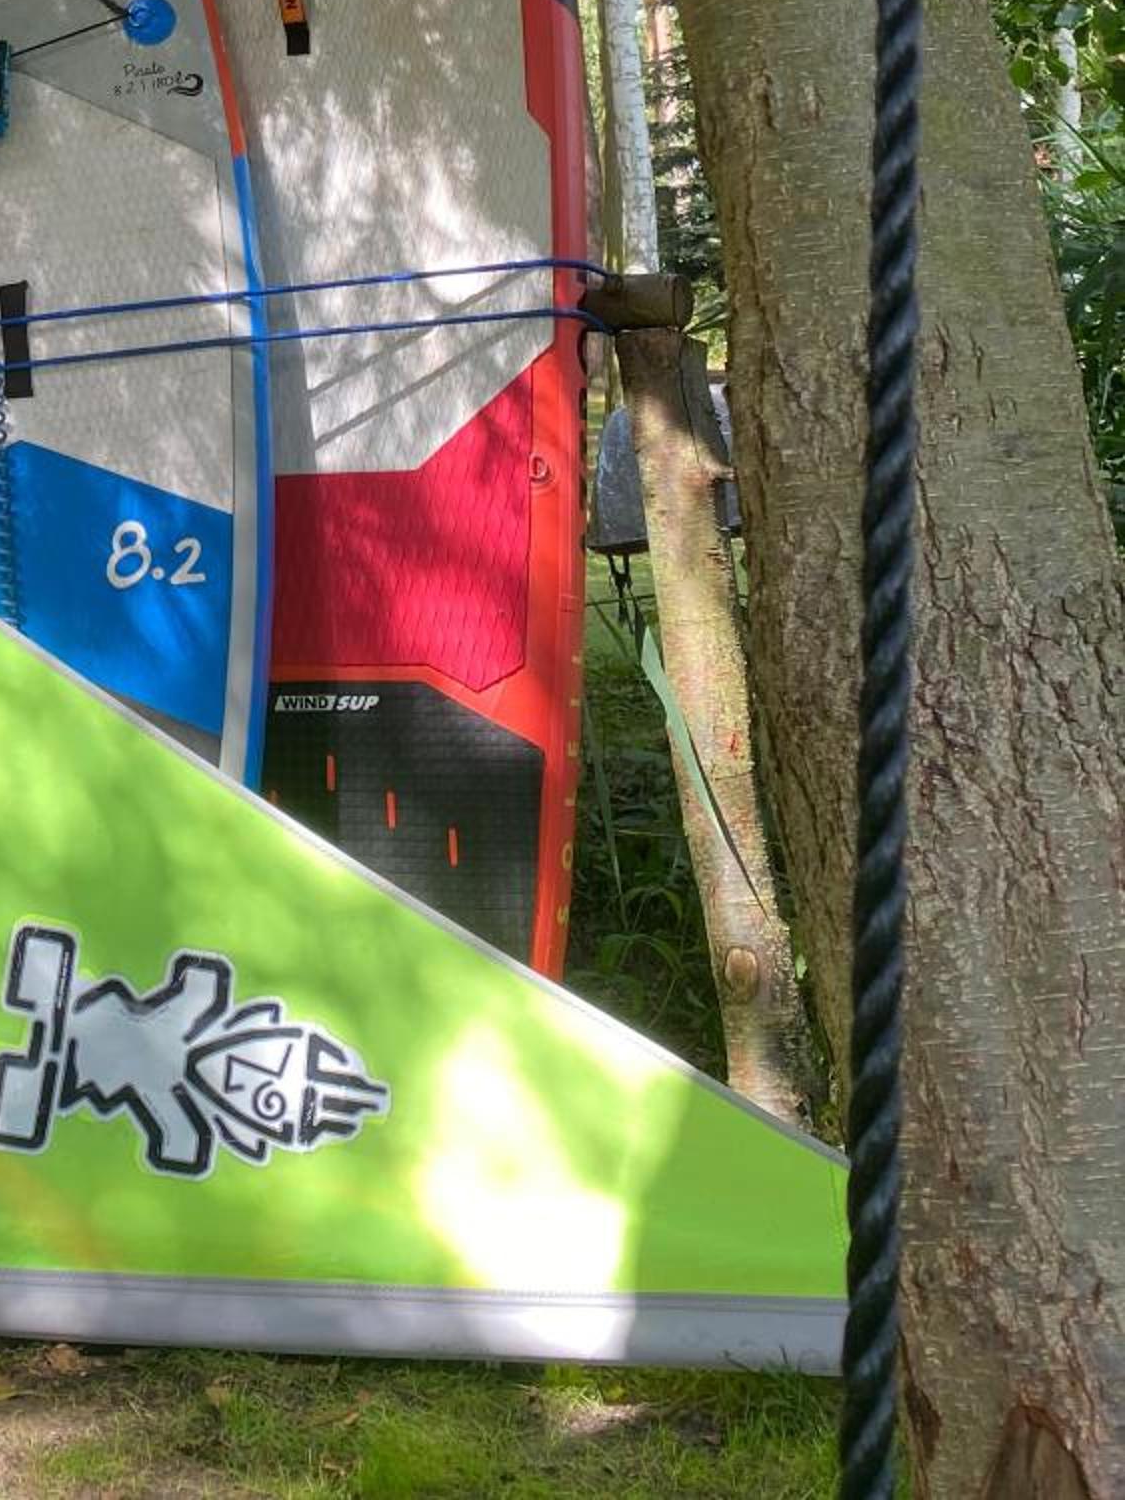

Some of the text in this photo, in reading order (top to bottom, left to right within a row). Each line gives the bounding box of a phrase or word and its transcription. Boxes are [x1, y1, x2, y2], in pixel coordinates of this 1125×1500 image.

[106, 519, 206, 589] 8.2
[279, 695, 380, 711] WIND SUP
